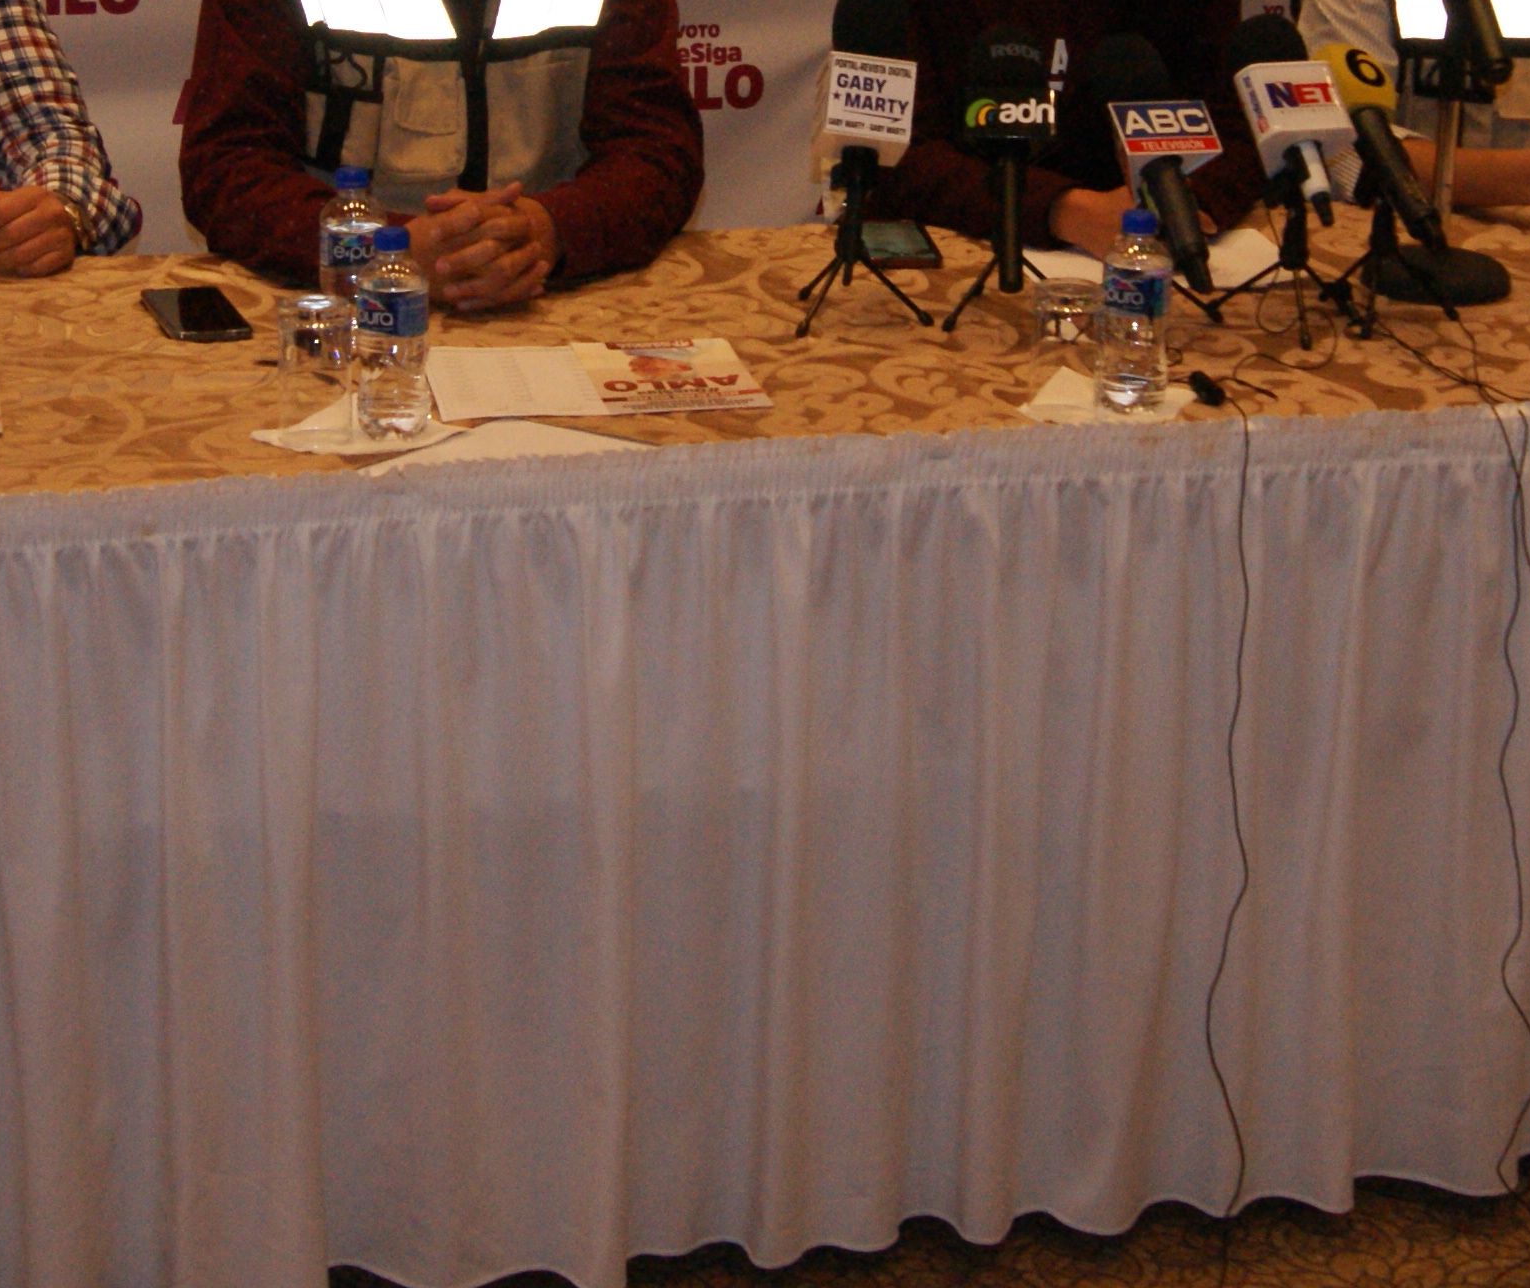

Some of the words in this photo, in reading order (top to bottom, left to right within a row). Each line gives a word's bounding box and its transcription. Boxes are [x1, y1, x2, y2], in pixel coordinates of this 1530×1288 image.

[1345, 48, 1386, 87] 6
[837, 73, 887, 93] GABY
[1265, 81, 1334, 108] NET
[844, 92, 910, 115] MARTY
[1125, 108, 1209, 135] ABC
